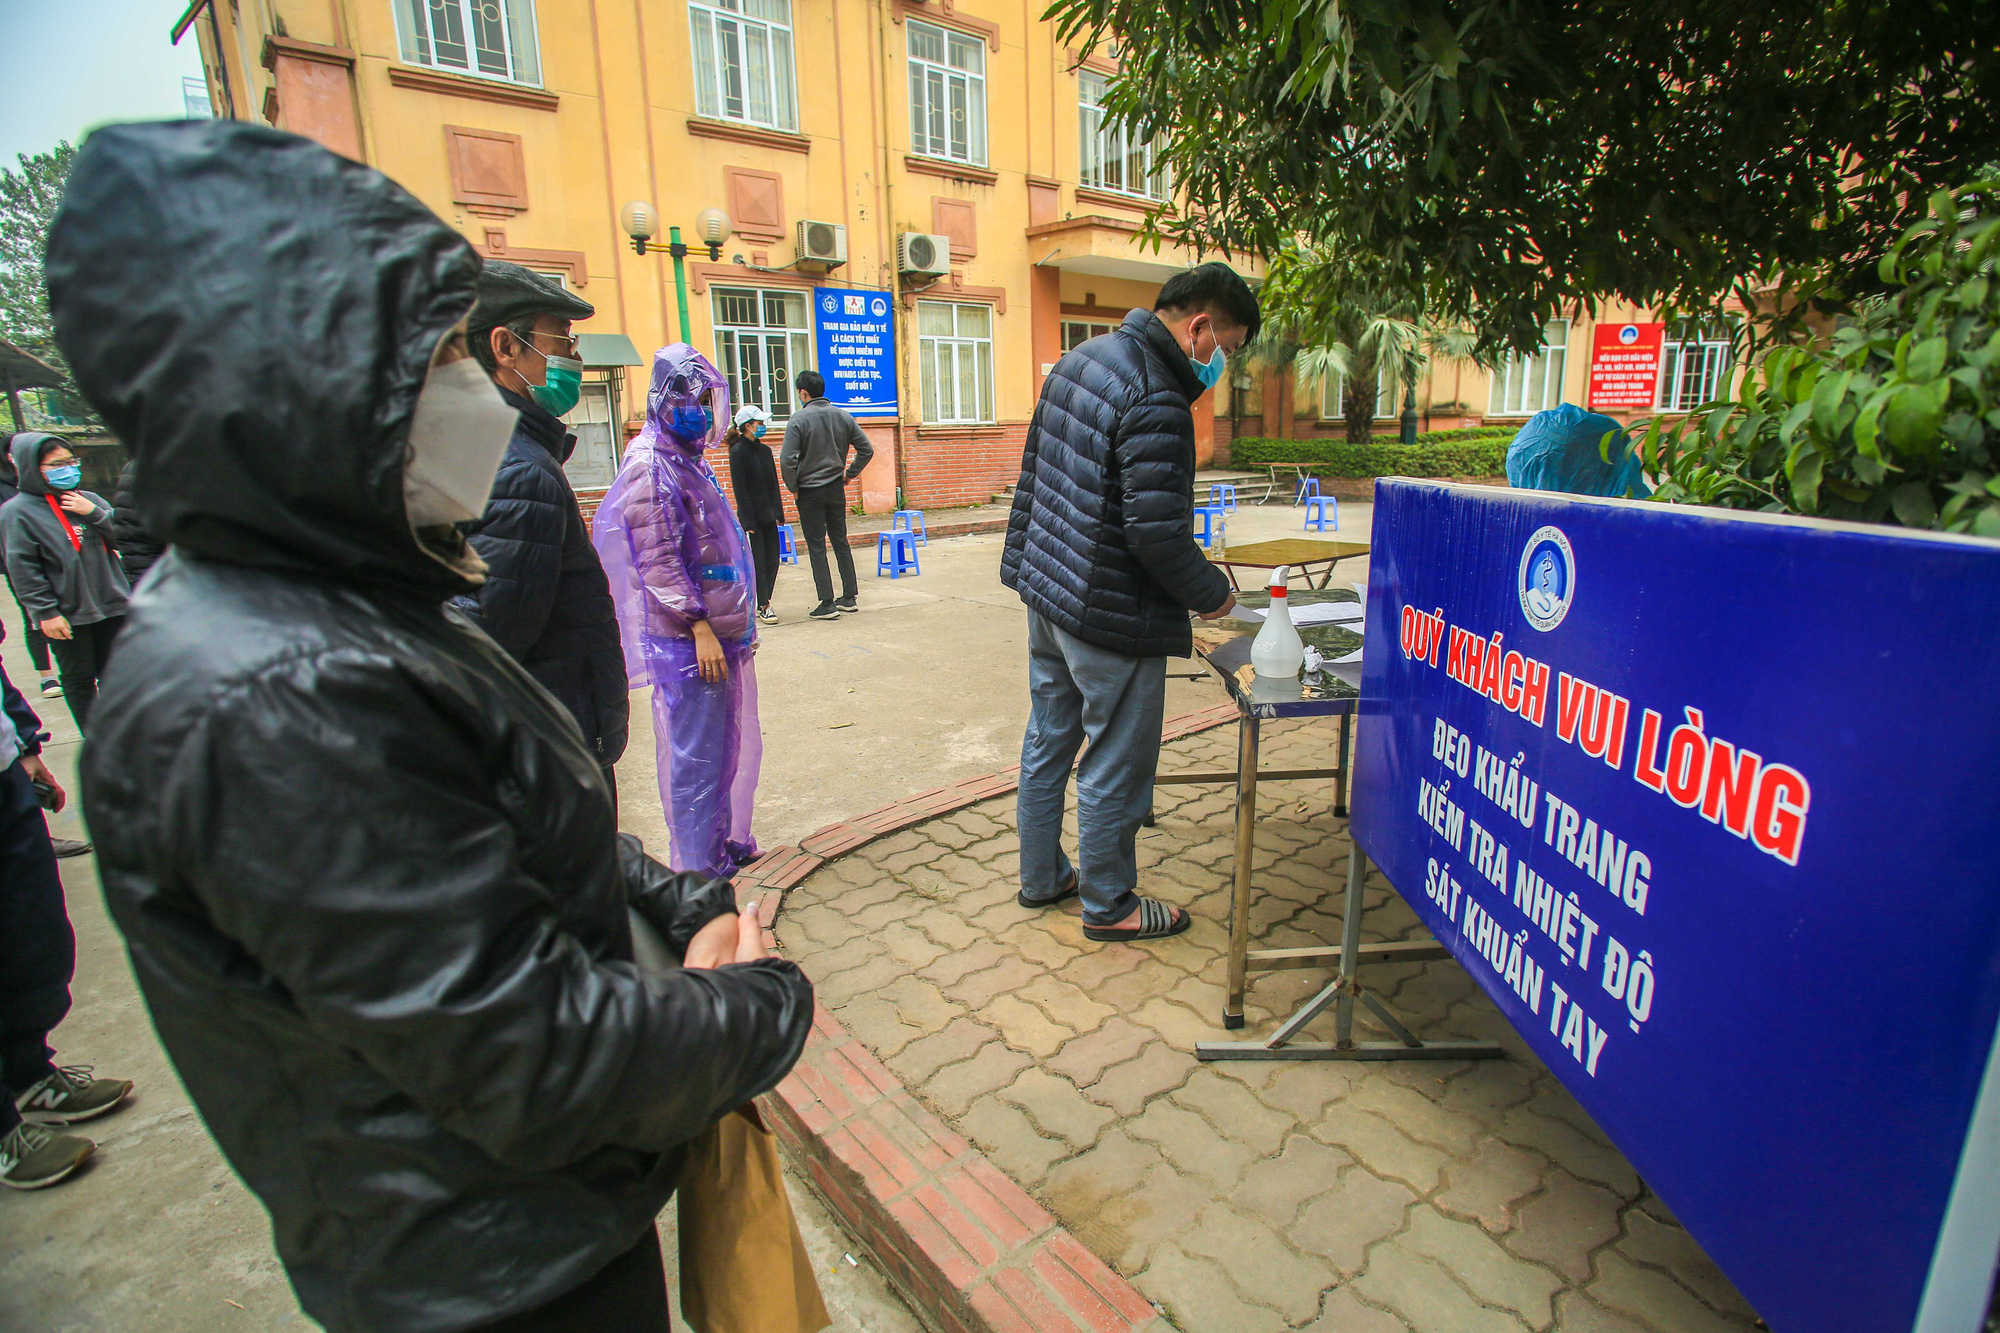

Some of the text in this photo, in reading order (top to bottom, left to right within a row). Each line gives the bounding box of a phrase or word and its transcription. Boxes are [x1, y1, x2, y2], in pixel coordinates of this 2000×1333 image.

[823, 322, 838, 330] THAM
[840, 323, 849, 331] GIA
[850, 321, 860, 331] BẢO
[880, 323, 887, 332] TẾ
[832, 333, 839, 342] LÀ
[840, 334, 854, 343] CÁCH
[855, 334, 865, 343] TỐT
[867, 359, 876, 368] TRỊ
[834, 370, 856, 378] HIV/AIDS
[857, 370, 869, 378] LIÊN
[845, 380, 858, 390] SUỐT
[1401, 604, 1811, 866] QUÝ KHÁCH VUI LÒNG
[1432, 717, 1651, 916] ĐEO KHẨU TRANG
[1417, 777, 1654, 1034] KIỂM TRA NHIỆT ĐỘ
[1425, 857, 1608, 1078] SÁT KHUẨN TAY
